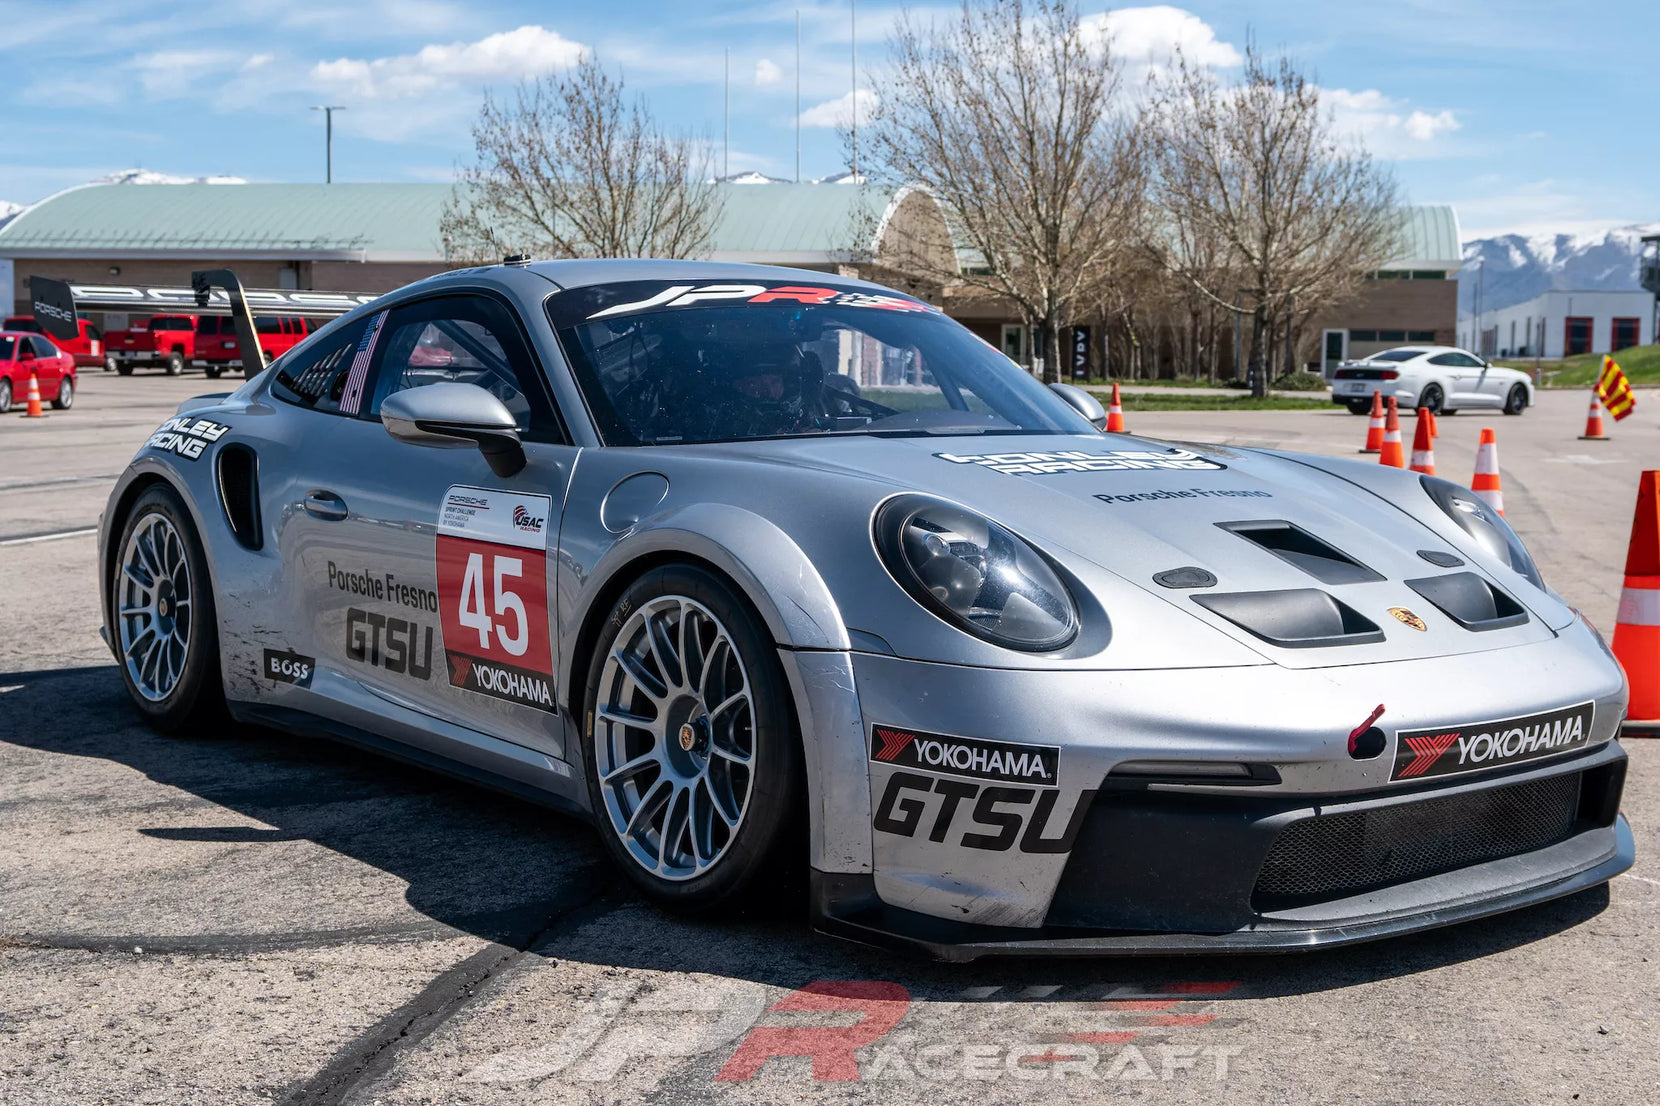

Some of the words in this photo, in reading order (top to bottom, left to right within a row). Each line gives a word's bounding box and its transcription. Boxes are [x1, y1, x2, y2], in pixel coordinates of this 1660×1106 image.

[34, 301, 72, 323] PORSCHE
[157, 418, 229, 442] ONLEY
[150, 432, 208, 459] ACING
[988, 459, 1223, 475] RACING
[448, 495, 488, 506] PORSCHE
[1092, 489, 1196, 504] Porsche
[1191, 488, 1273, 498] Fresno
[516, 515, 544, 528] USAC
[328, 560, 384, 601] Porsche
[386, 574, 439, 613] Fresno
[459, 552, 529, 657] 45
[346, 607, 434, 681] GTSU
[271, 657, 309, 680] BOSS
[472, 662, 553, 706] YOKOHAMA
[1457, 715, 1583, 765] YOKOHAMA
[914, 738, 1047, 779] YOKOHAMA
[873, 771, 1100, 854] GTSU
